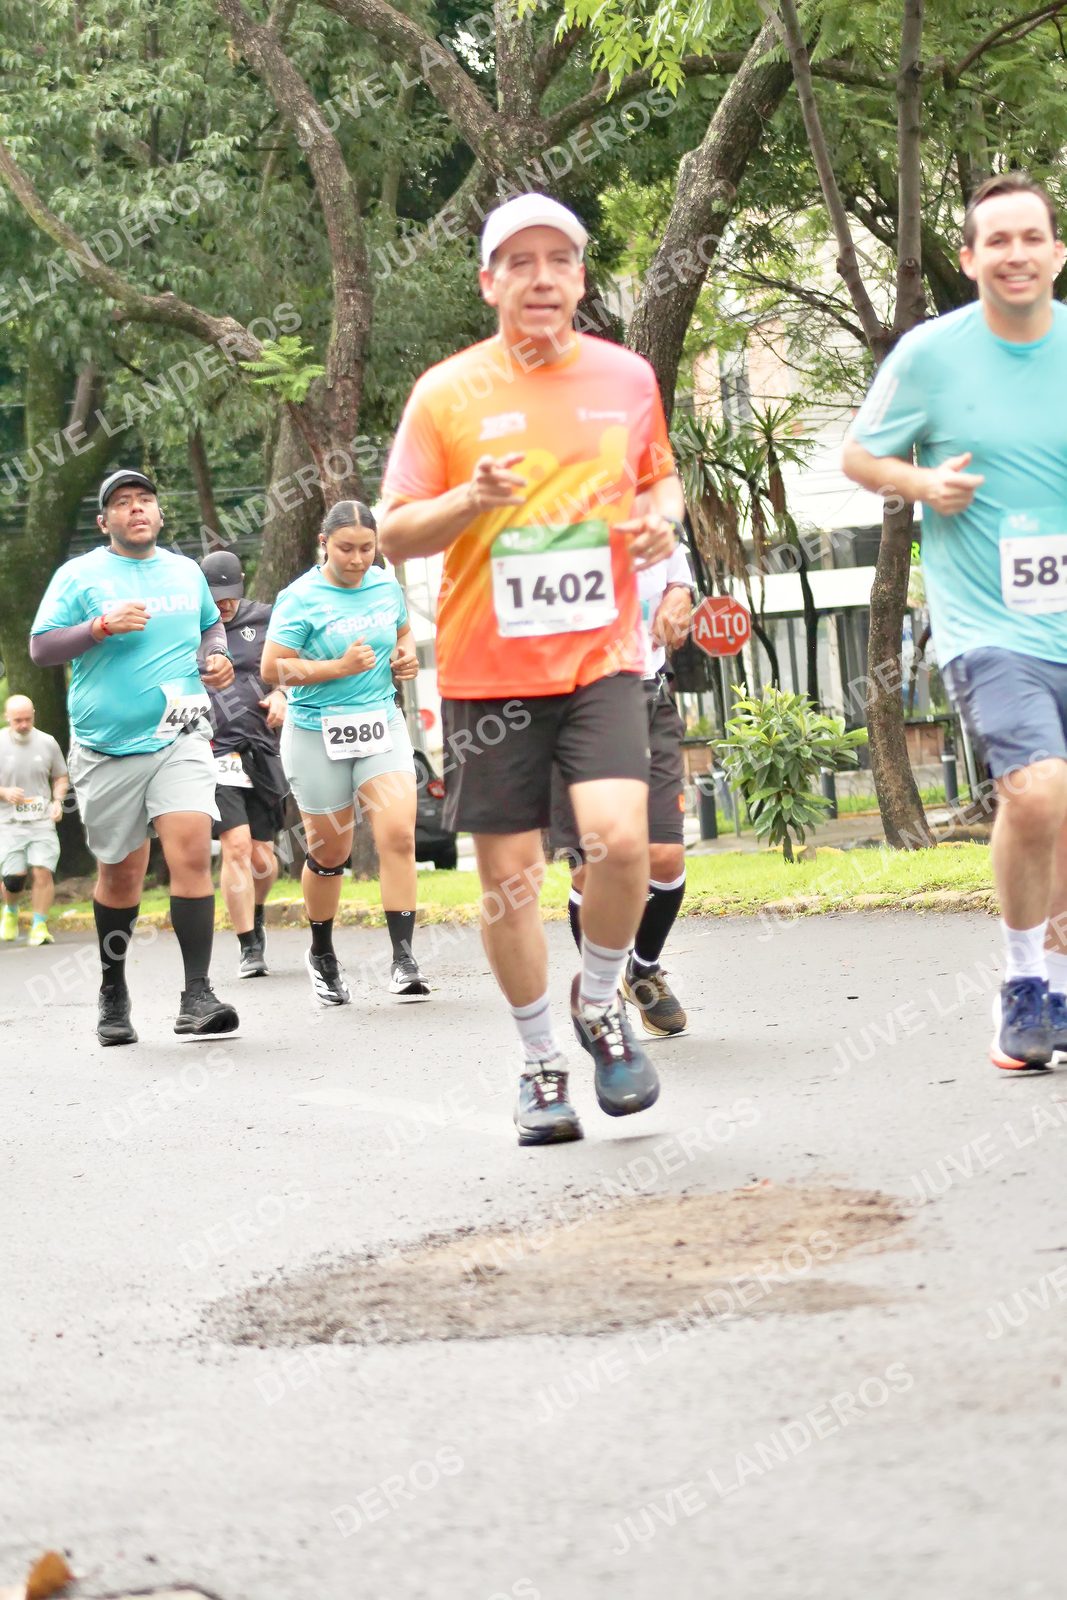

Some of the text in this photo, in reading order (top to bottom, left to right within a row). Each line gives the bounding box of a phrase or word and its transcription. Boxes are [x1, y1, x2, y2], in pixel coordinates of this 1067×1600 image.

[1012, 555, 1067, 588] 58
[506, 570, 606, 608] 1402
[102, 593, 200, 615] PDURA
[698, 612, 747, 640] ALTO
[328, 721, 385, 745] 2980
